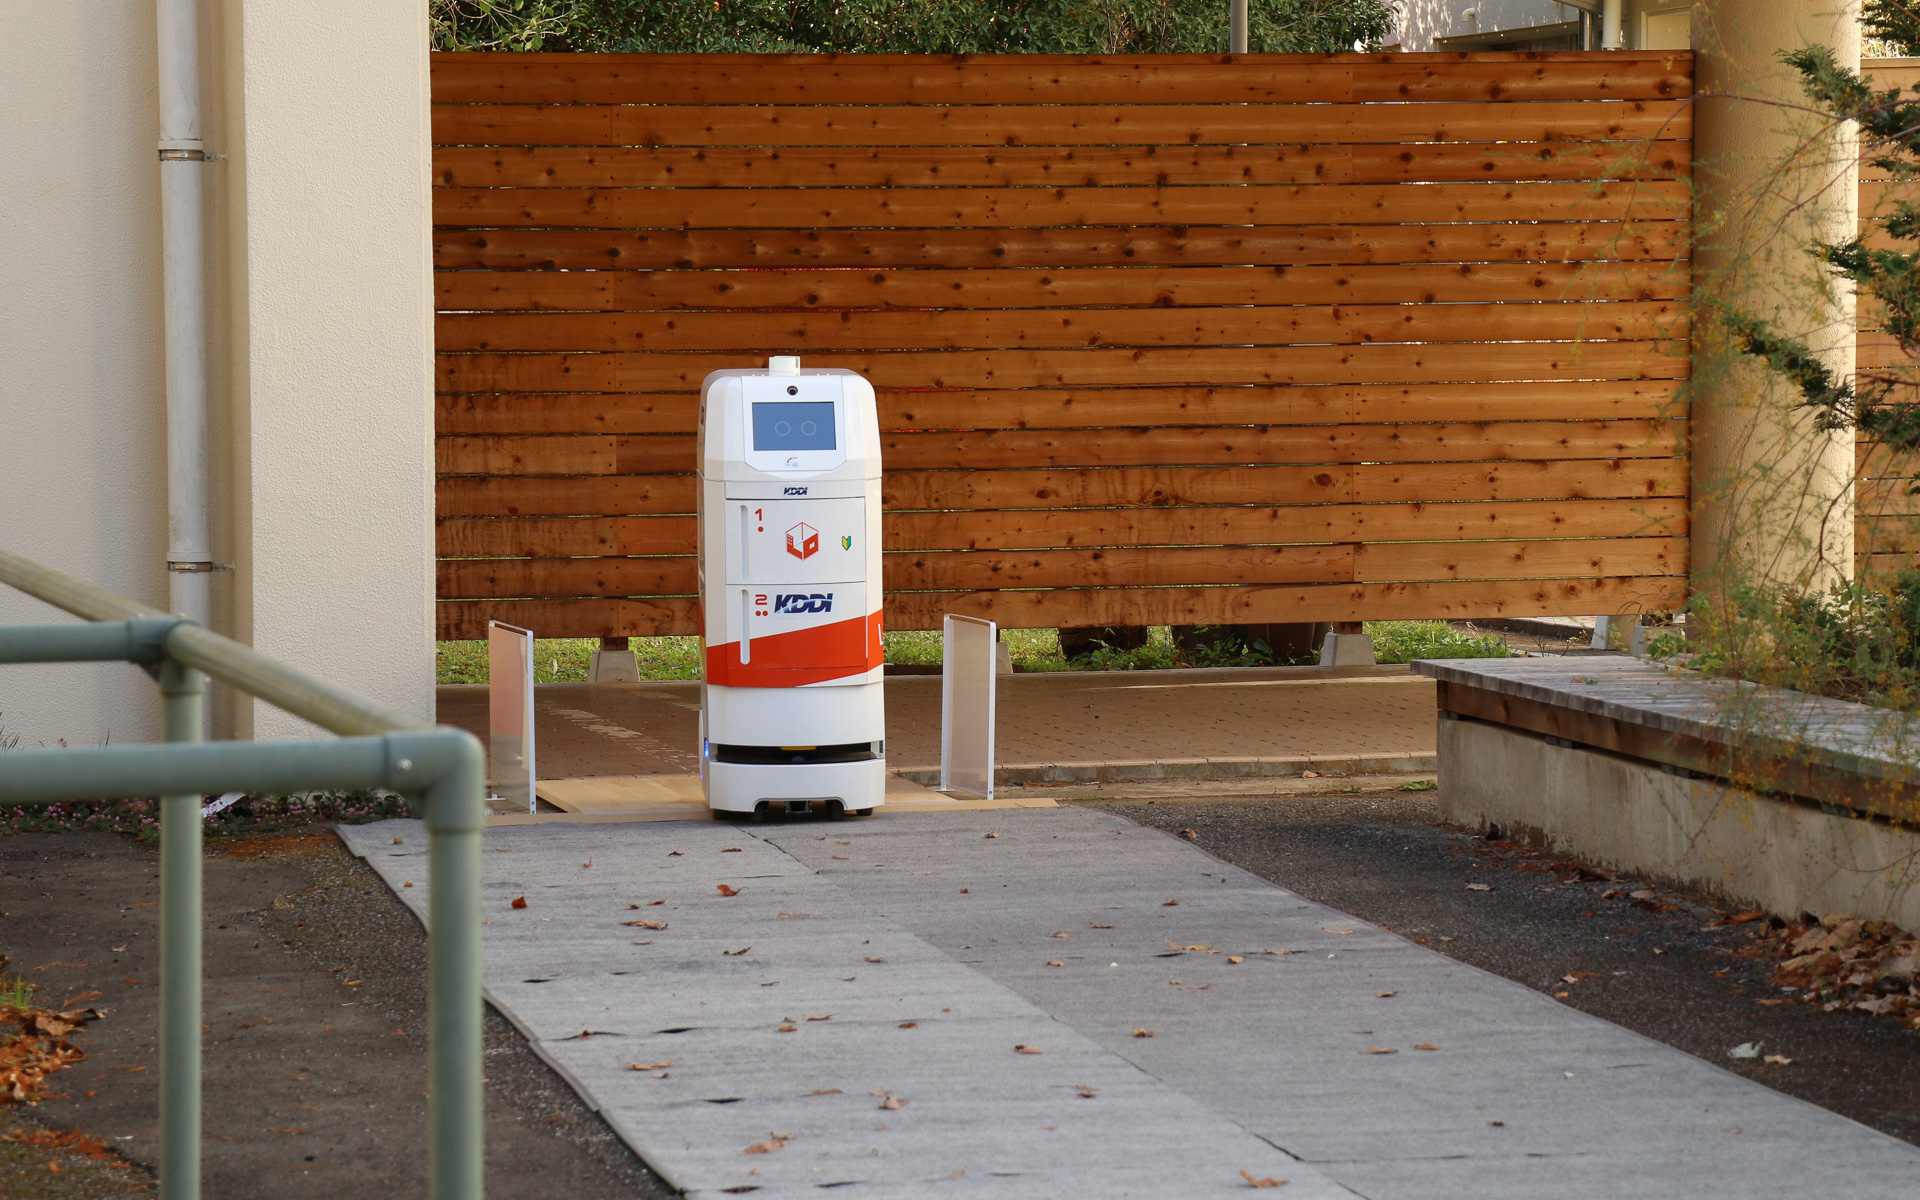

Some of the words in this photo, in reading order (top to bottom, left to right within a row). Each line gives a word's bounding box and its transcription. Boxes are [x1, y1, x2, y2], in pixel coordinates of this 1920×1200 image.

[783, 487, 808, 496] KDDI
[754, 508, 763, 522] 1
[755, 594, 768, 606] 2
[774, 593, 834, 614] KDDI
